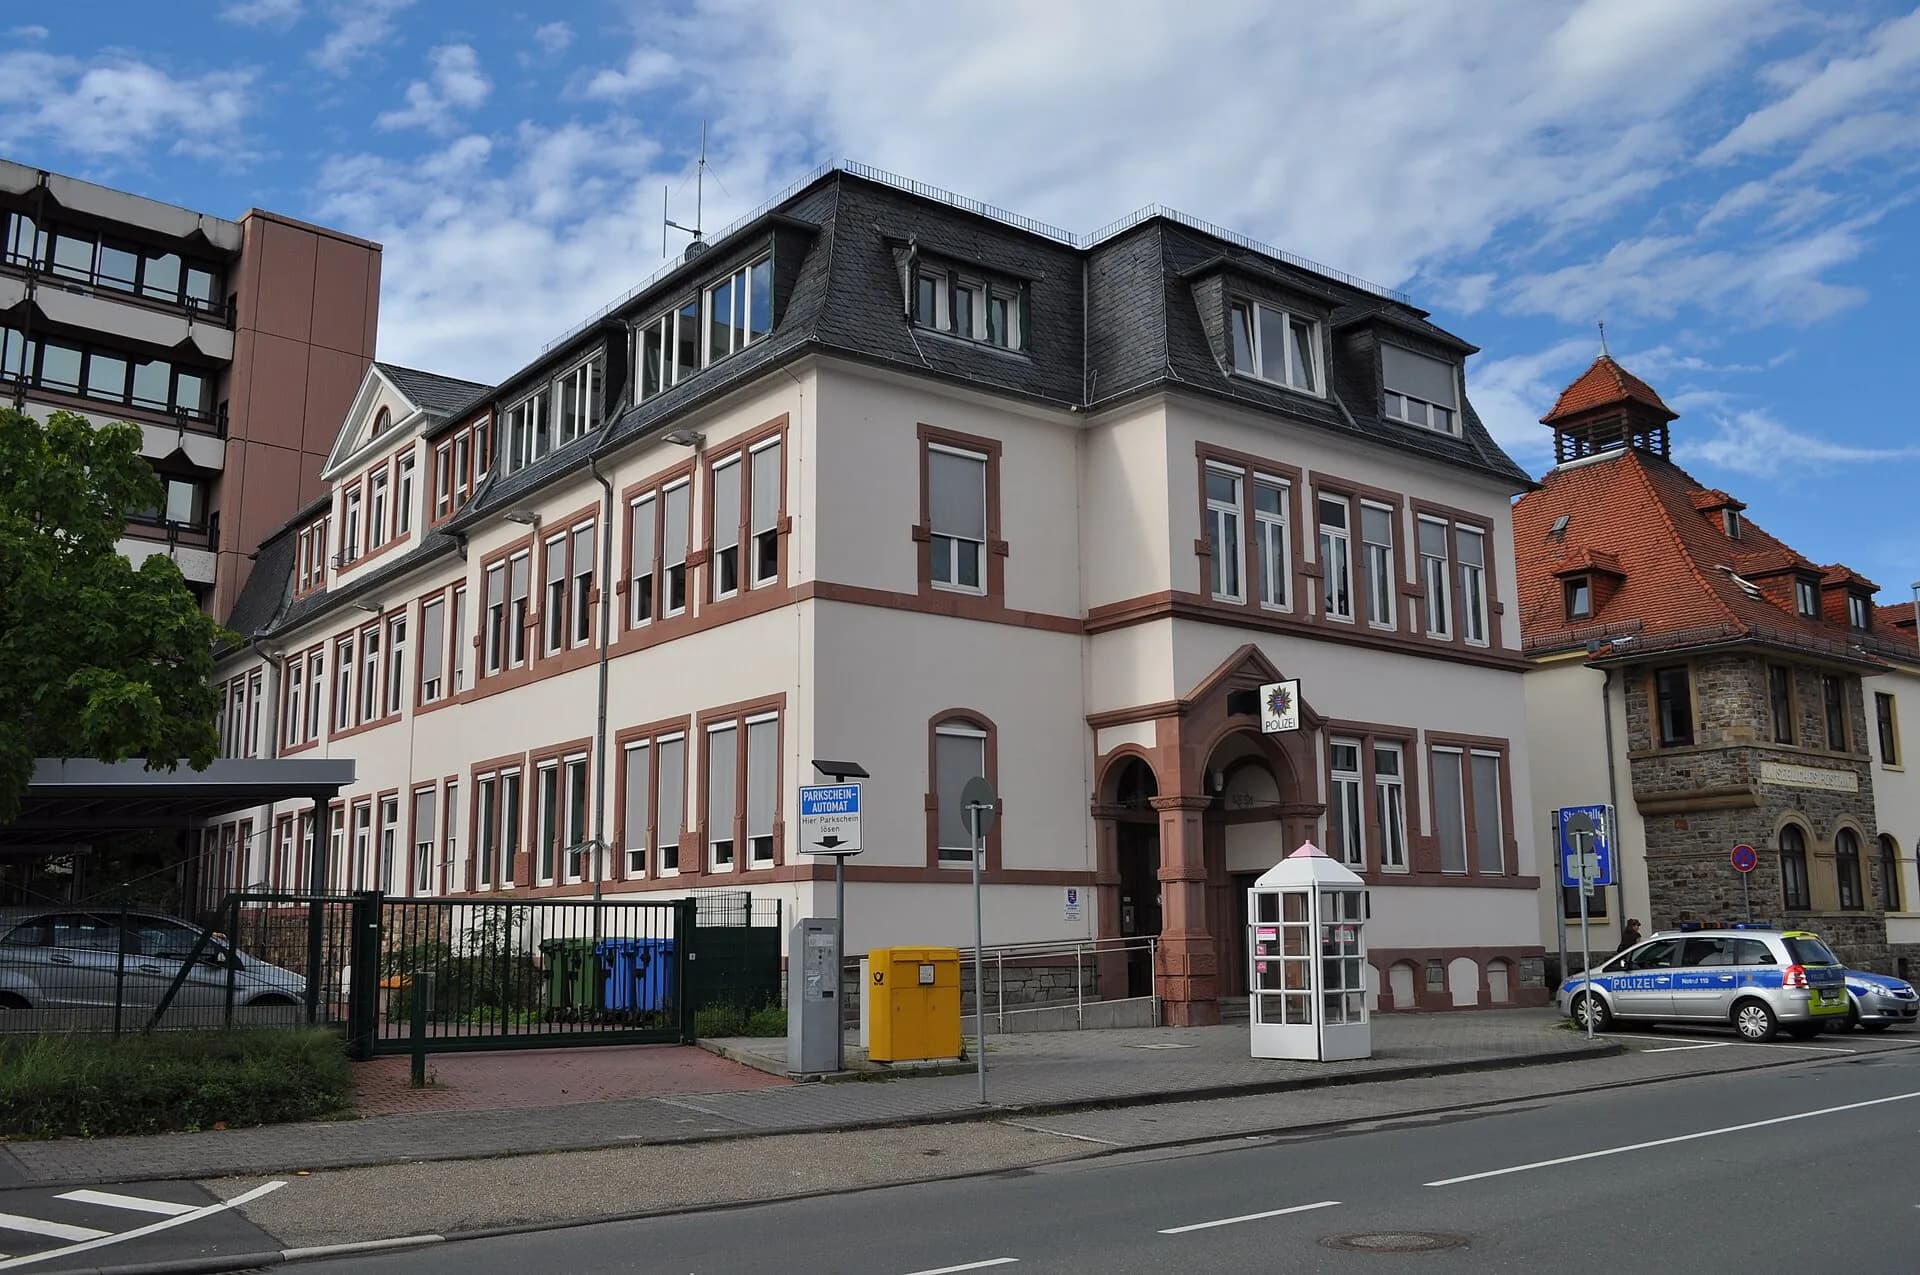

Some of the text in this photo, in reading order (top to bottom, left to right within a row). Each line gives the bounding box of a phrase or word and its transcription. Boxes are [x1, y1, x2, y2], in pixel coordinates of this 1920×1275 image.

[1265, 718, 1296, 731] POLIZEI
[803, 788, 857, 802] PARKSCHEIN-
[812, 801, 848, 813] AUTOMAT
[802, 815, 859, 825] Hier Parkschein
[820, 825, 840, 833] lösen
[1613, 978, 1655, 989] POLIZEI
